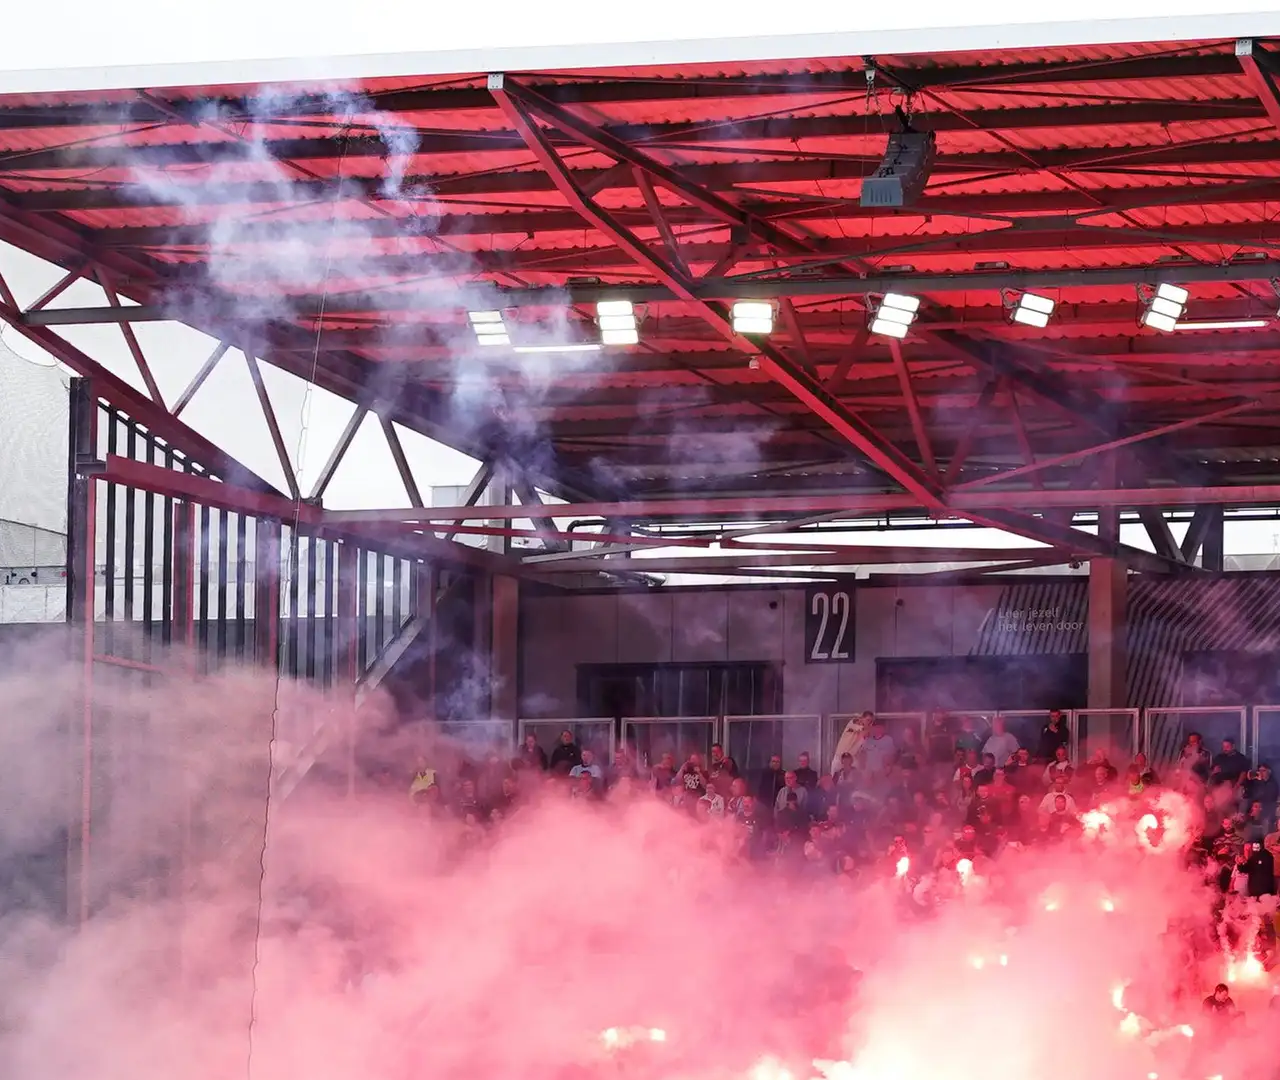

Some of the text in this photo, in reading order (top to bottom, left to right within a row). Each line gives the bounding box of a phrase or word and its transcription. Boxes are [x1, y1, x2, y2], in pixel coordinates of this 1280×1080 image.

[1028, 607, 1061, 620] jezelf
[812, 591, 849, 659] 22
[998, 620, 1084, 632] het leven door
